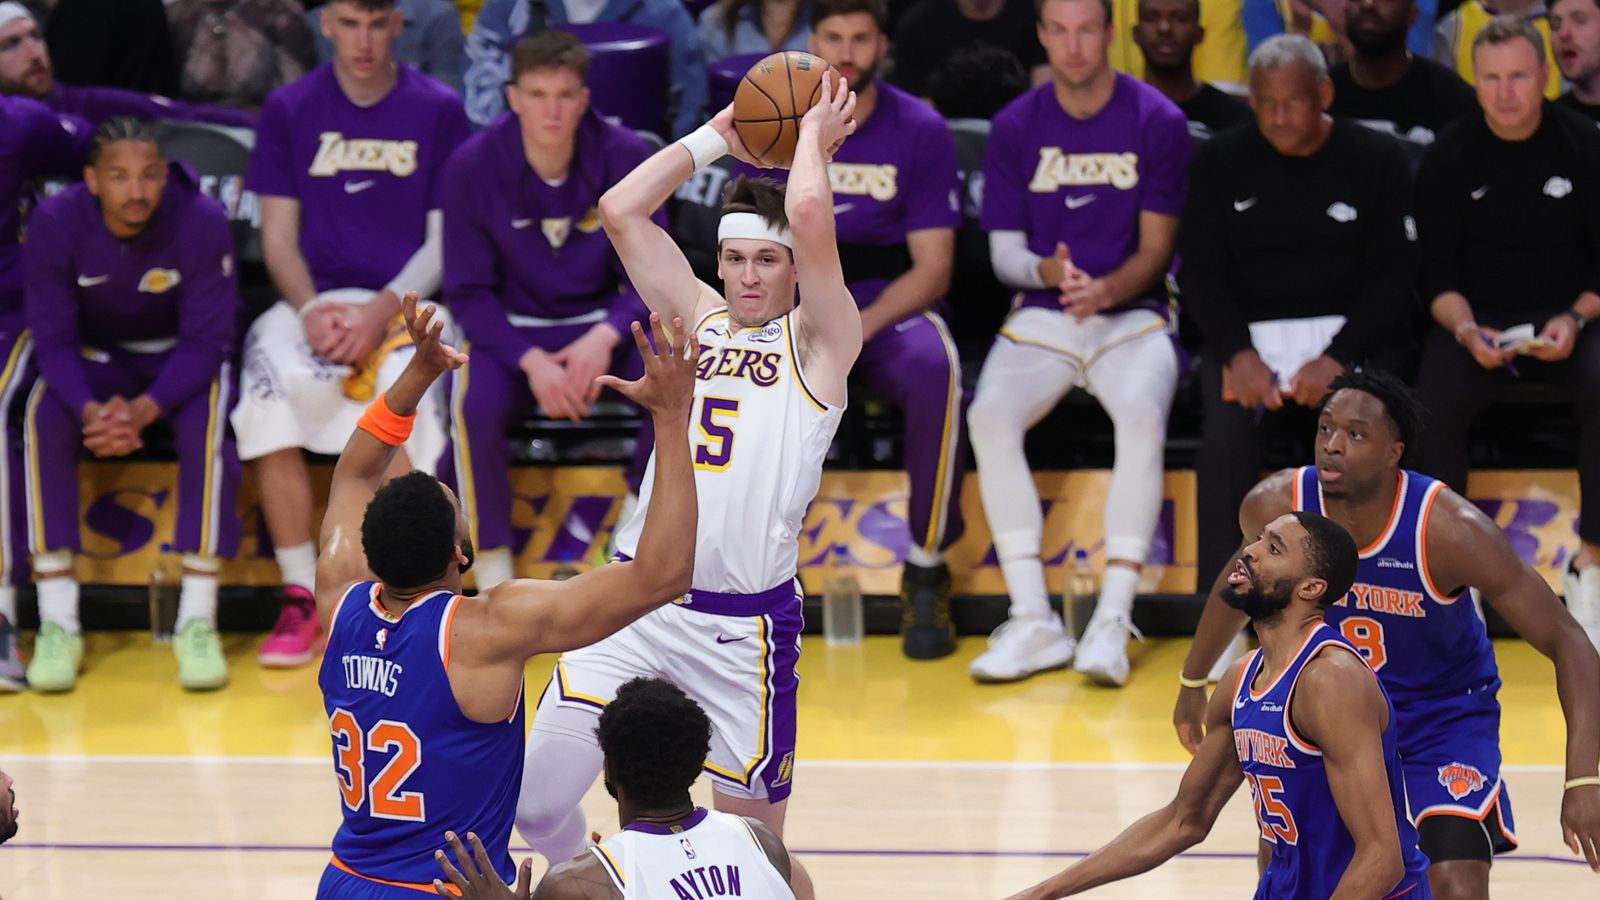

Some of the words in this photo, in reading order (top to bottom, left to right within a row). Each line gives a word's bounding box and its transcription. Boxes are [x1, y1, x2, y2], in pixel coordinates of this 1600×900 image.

[826, 162, 898, 202] KERS
[688, 395, 742, 473] 5
[1350, 582, 1426, 618] YORK
[1339, 616, 1387, 673] 8
[342, 655, 403, 698] TOWNS
[329, 707, 425, 823] 32
[1247, 729, 1297, 769] YORK
[669, 865, 741, 900] AYTON
